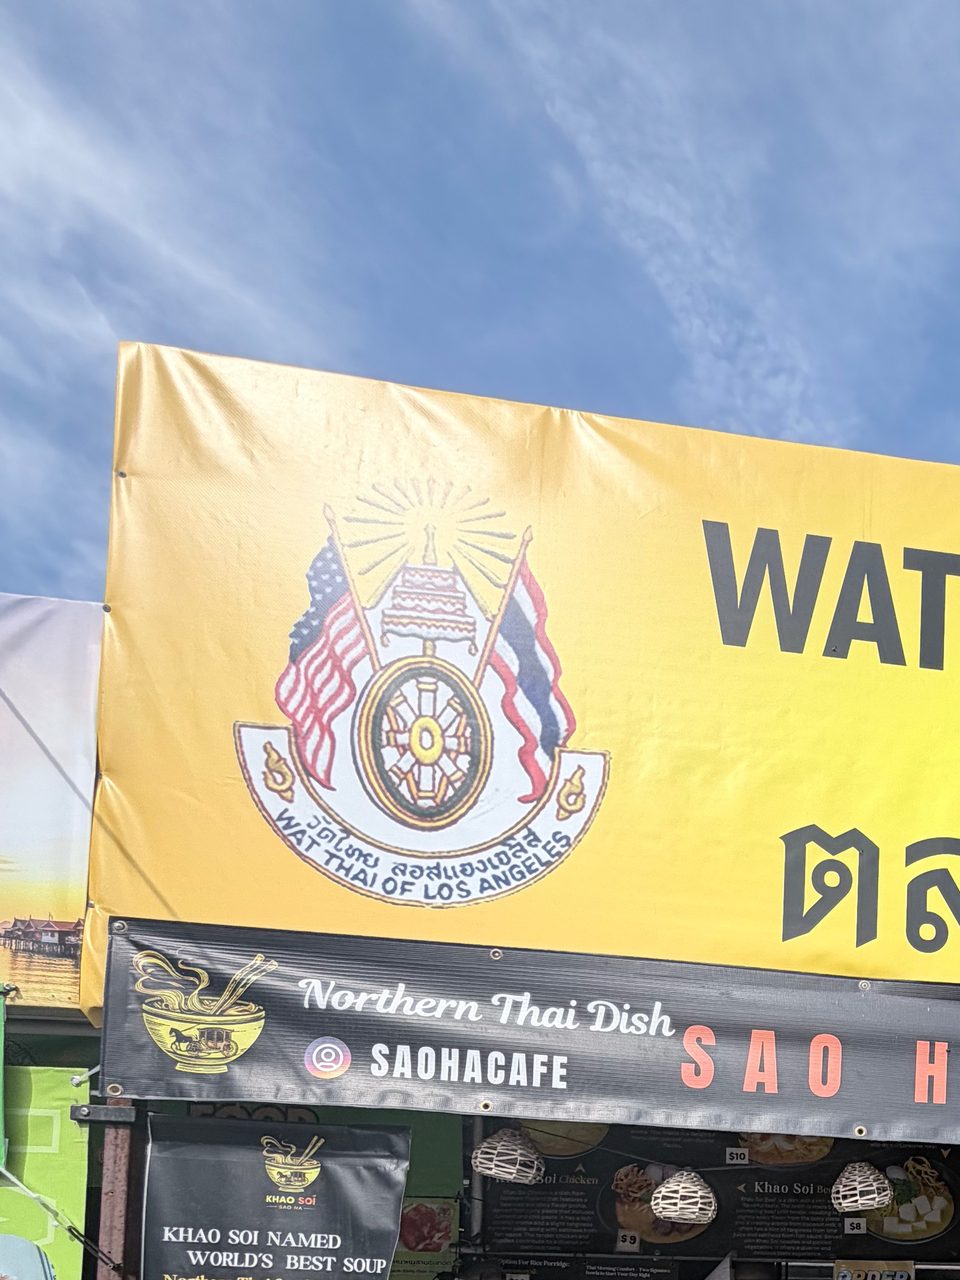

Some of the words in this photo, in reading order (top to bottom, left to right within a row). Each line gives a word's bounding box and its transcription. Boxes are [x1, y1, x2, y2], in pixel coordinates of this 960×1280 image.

[275, 808, 316, 852] WAT
[323, 852, 377, 888] THAI
[382, 876, 416, 896] OF
[424, 881, 471, 900] LOS
[479, 831, 571, 894] ANGELES
[298, 977, 484, 1022] Northern
[491, 992, 578, 1032] Thai
[587, 998, 676, 1039] Dish
[371, 1043, 568, 1089] SAOHACAFE
[680, 1025, 843, 1098] SAO
[729, 1151, 746, 1161] $10
[754, 1182, 789, 1195] Khao
[793, 1183, 814, 1195] Soi
[266, 1195, 295, 1204] KHAO
[849, 1221, 861, 1231] $8
[163, 1226, 221, 1244] KHAO
[228, 1230, 259, 1245] SOI
[266, 1231, 341, 1249] NAMED
[286, 1255, 337, 1272] BEST
[343, 1257, 387, 1274] SOUP
